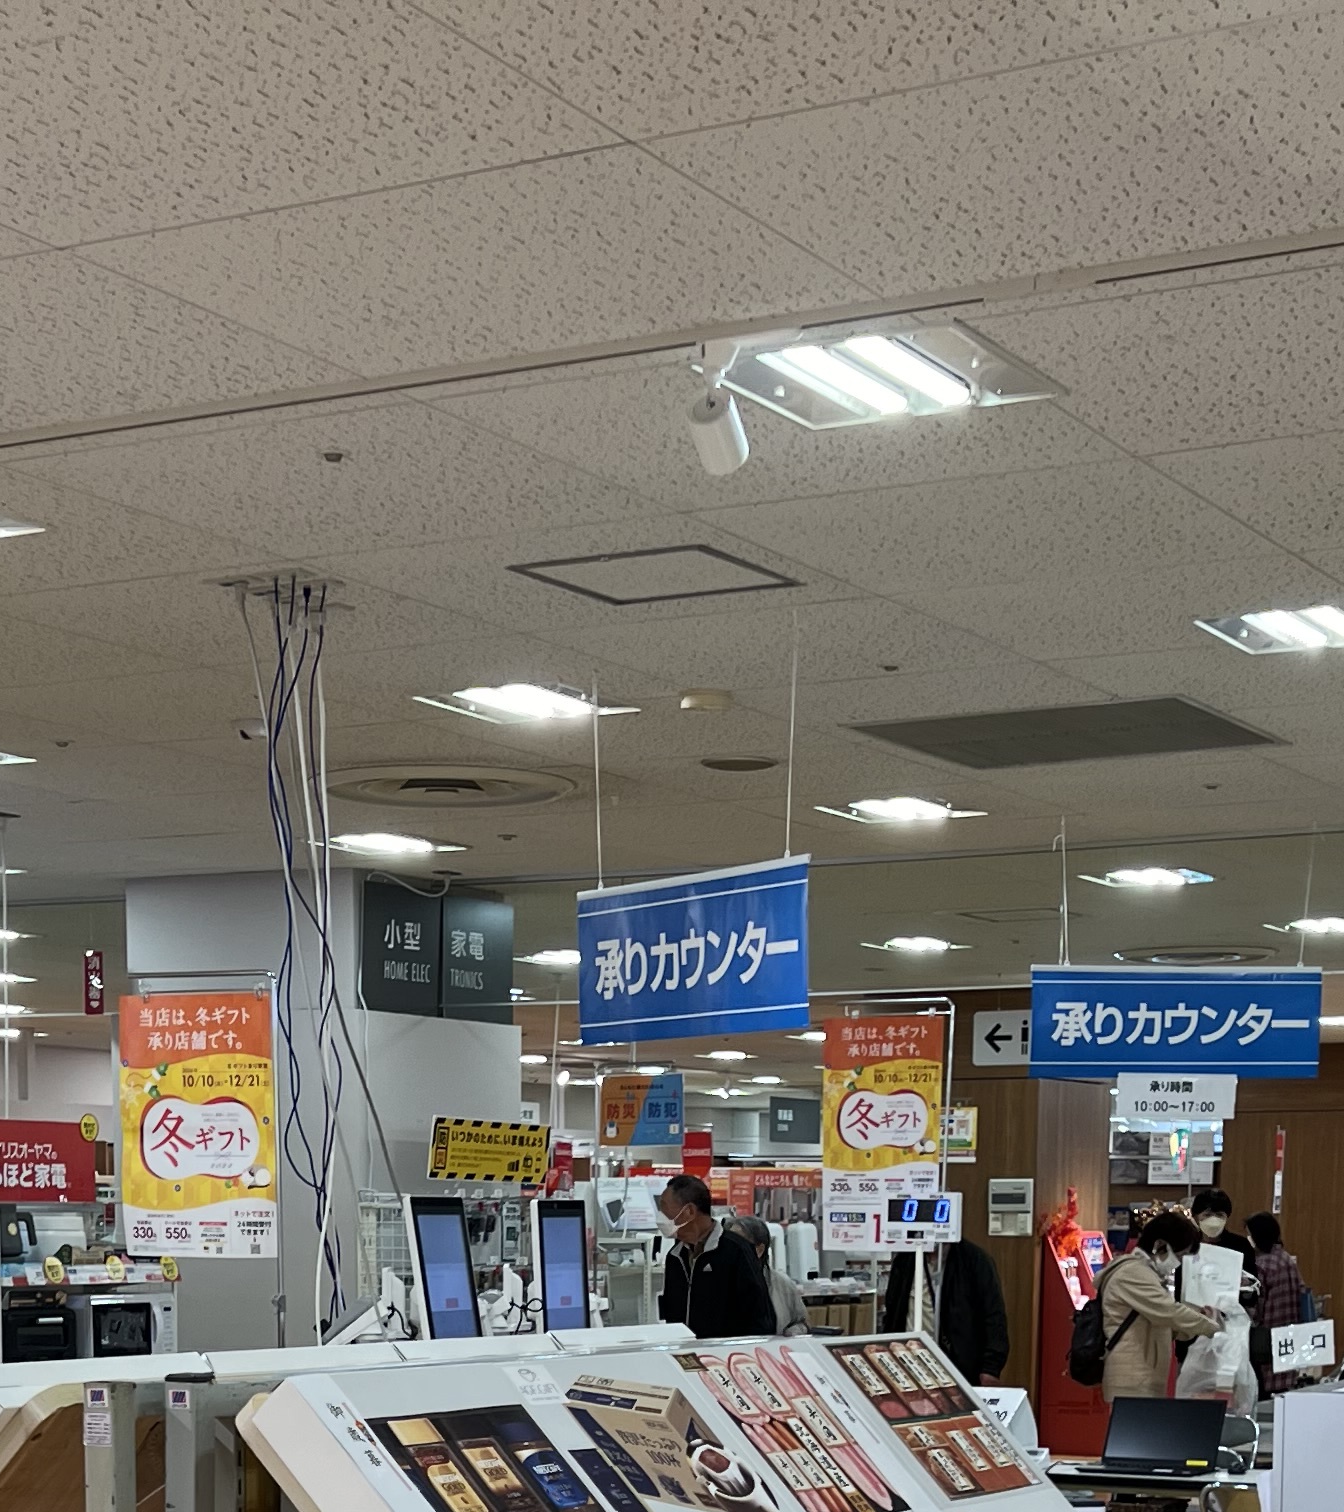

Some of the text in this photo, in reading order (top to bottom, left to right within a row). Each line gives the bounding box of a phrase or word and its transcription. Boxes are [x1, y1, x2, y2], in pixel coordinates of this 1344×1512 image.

[384, 919, 421, 950] 小型
[451, 929, 485, 961] 家電
[595, 919, 800, 1001] 承りカウンター
[384, 960, 431, 984] HOME ELEC
[450, 968, 484, 990] TRONICS
[139, 1006, 251, 1028] 当店は、冬ギフト
[1051, 1001, 1310, 1046] 承りカウンター
[147, 1029, 243, 1051] 承り店舗です。
[841, 1025, 928, 1041] 当店は、冬ギフト
[1149, 1080, 1193, 1094] 承り時間
[606, 1102, 637, 1119] 防災
[647, 1101, 678, 1118] 防犯
[845, 1098, 922, 1140] 冬ギフト
[150, 1108, 251, 1168] 冬ギフト
